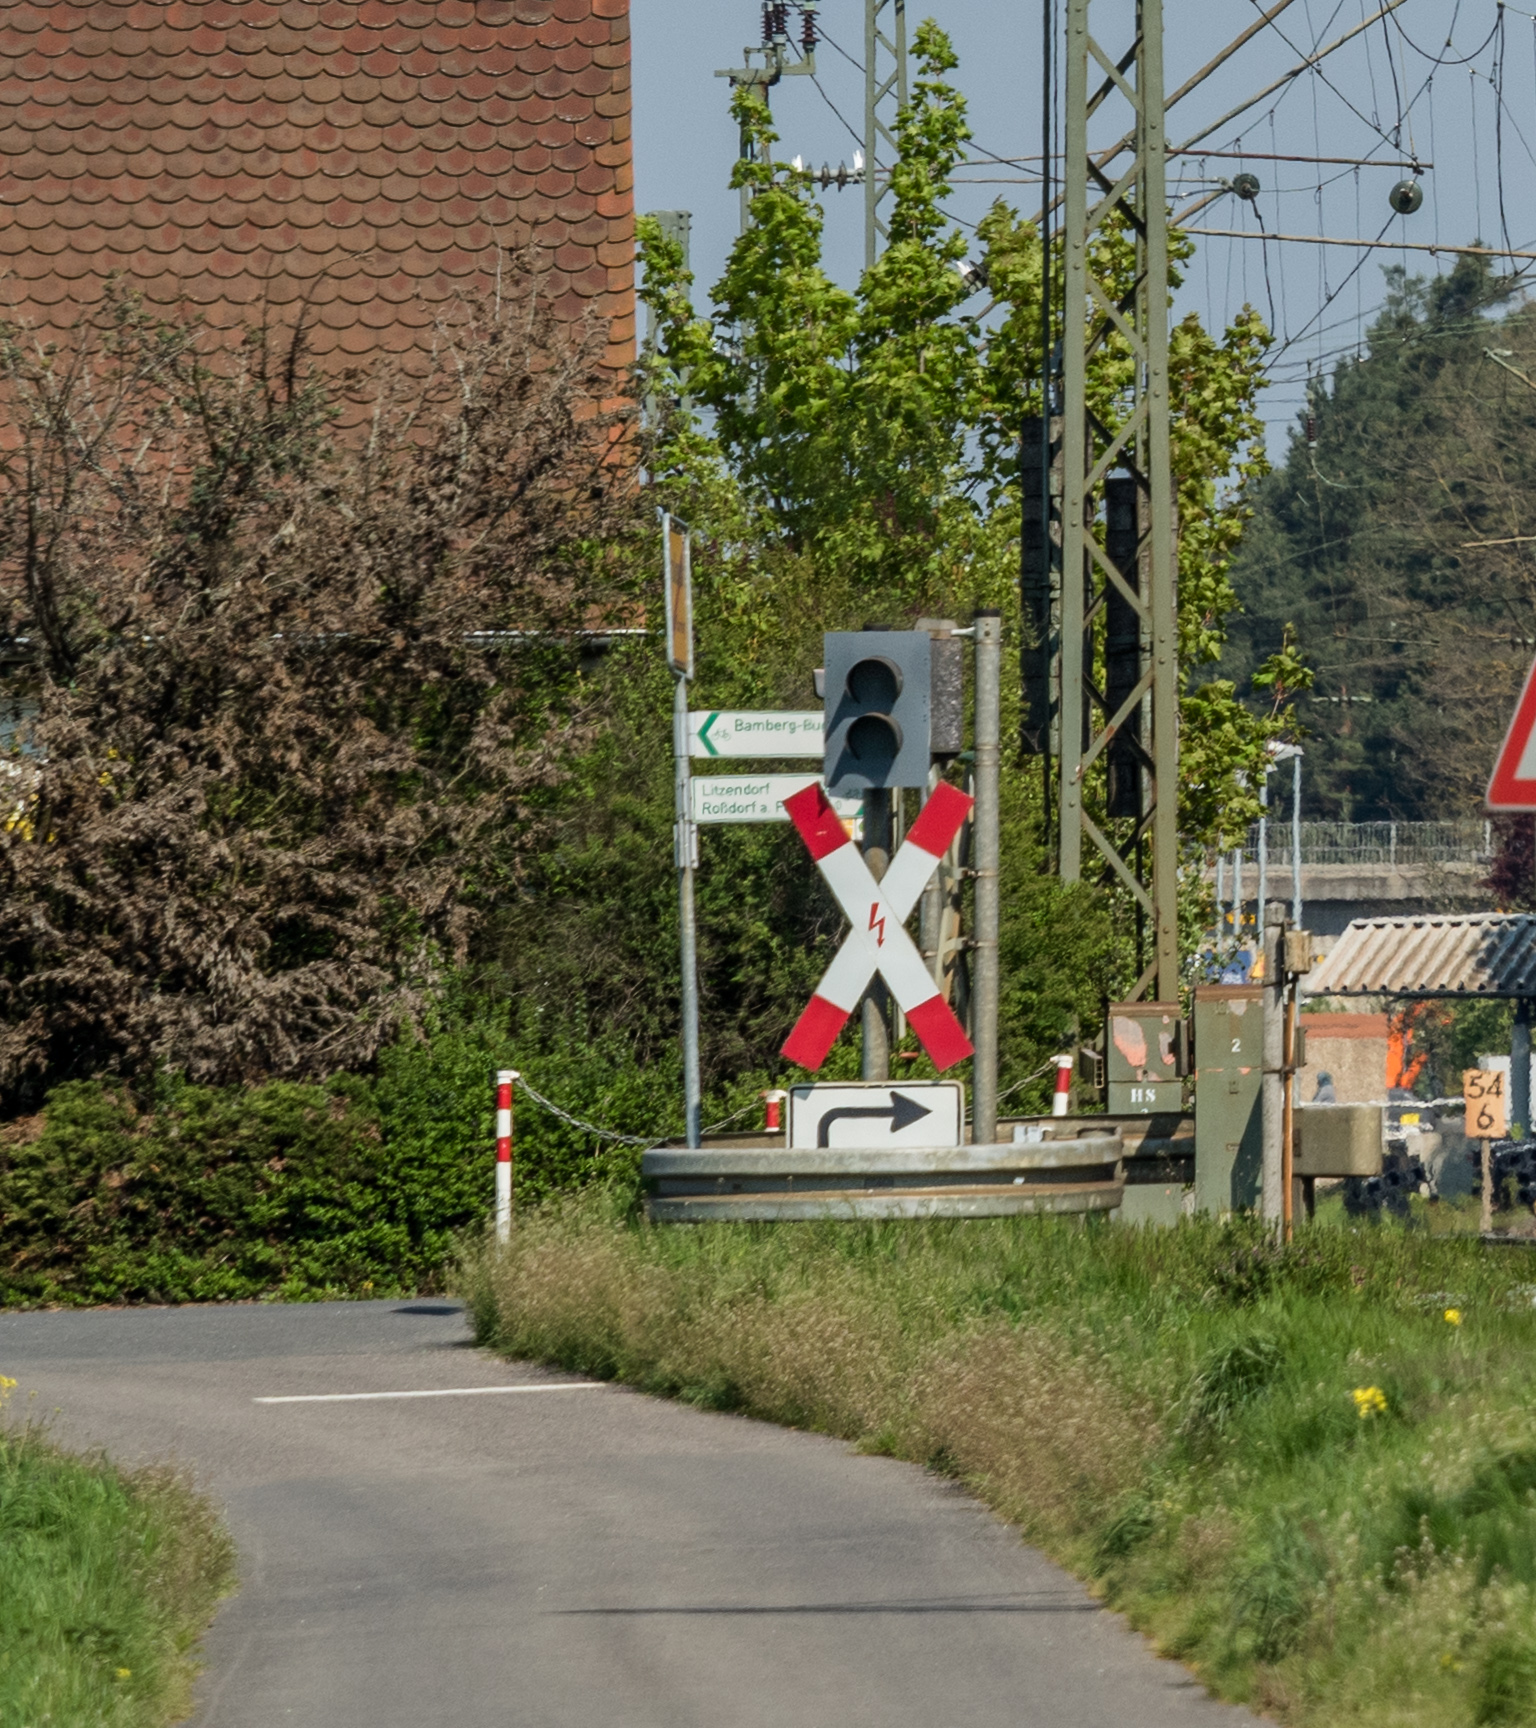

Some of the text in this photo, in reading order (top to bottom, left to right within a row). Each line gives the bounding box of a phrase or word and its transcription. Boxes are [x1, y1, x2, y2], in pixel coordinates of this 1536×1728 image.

[702, 783, 770, 797] Litzendorf
[702, 801, 757, 815] Roßdorf
[1231, 1038, 1242, 1053] 2
[1467, 1072, 1503, 1100] 54
[1130, 1088, 1157, 1103] HS
[1476, 1103, 1495, 1130] 6
